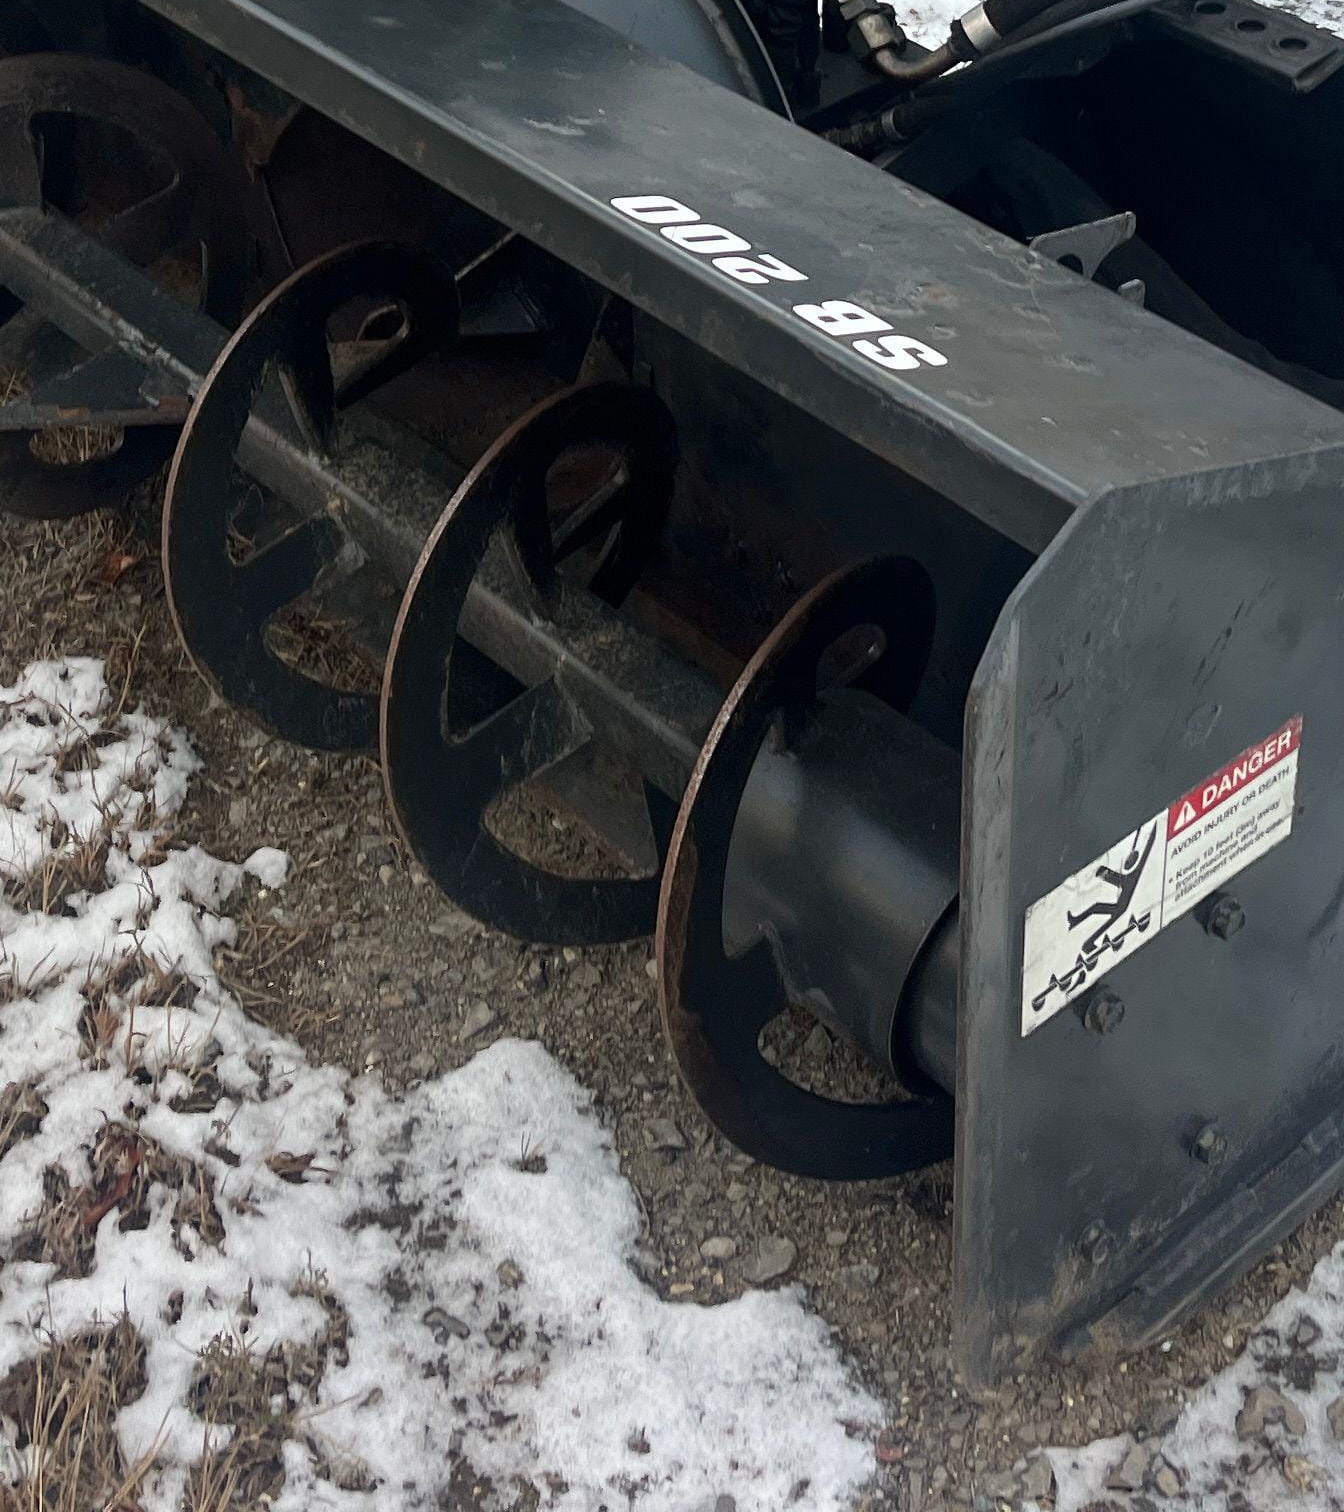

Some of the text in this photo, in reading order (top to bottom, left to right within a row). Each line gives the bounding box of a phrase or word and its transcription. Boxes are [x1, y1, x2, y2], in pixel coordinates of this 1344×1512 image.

[609, 195, 949, 371] SB 200
[1171, 766, 1290, 859] AVOID INJURY OR DEATH
[1202, 729, 1292, 809] DANGER
